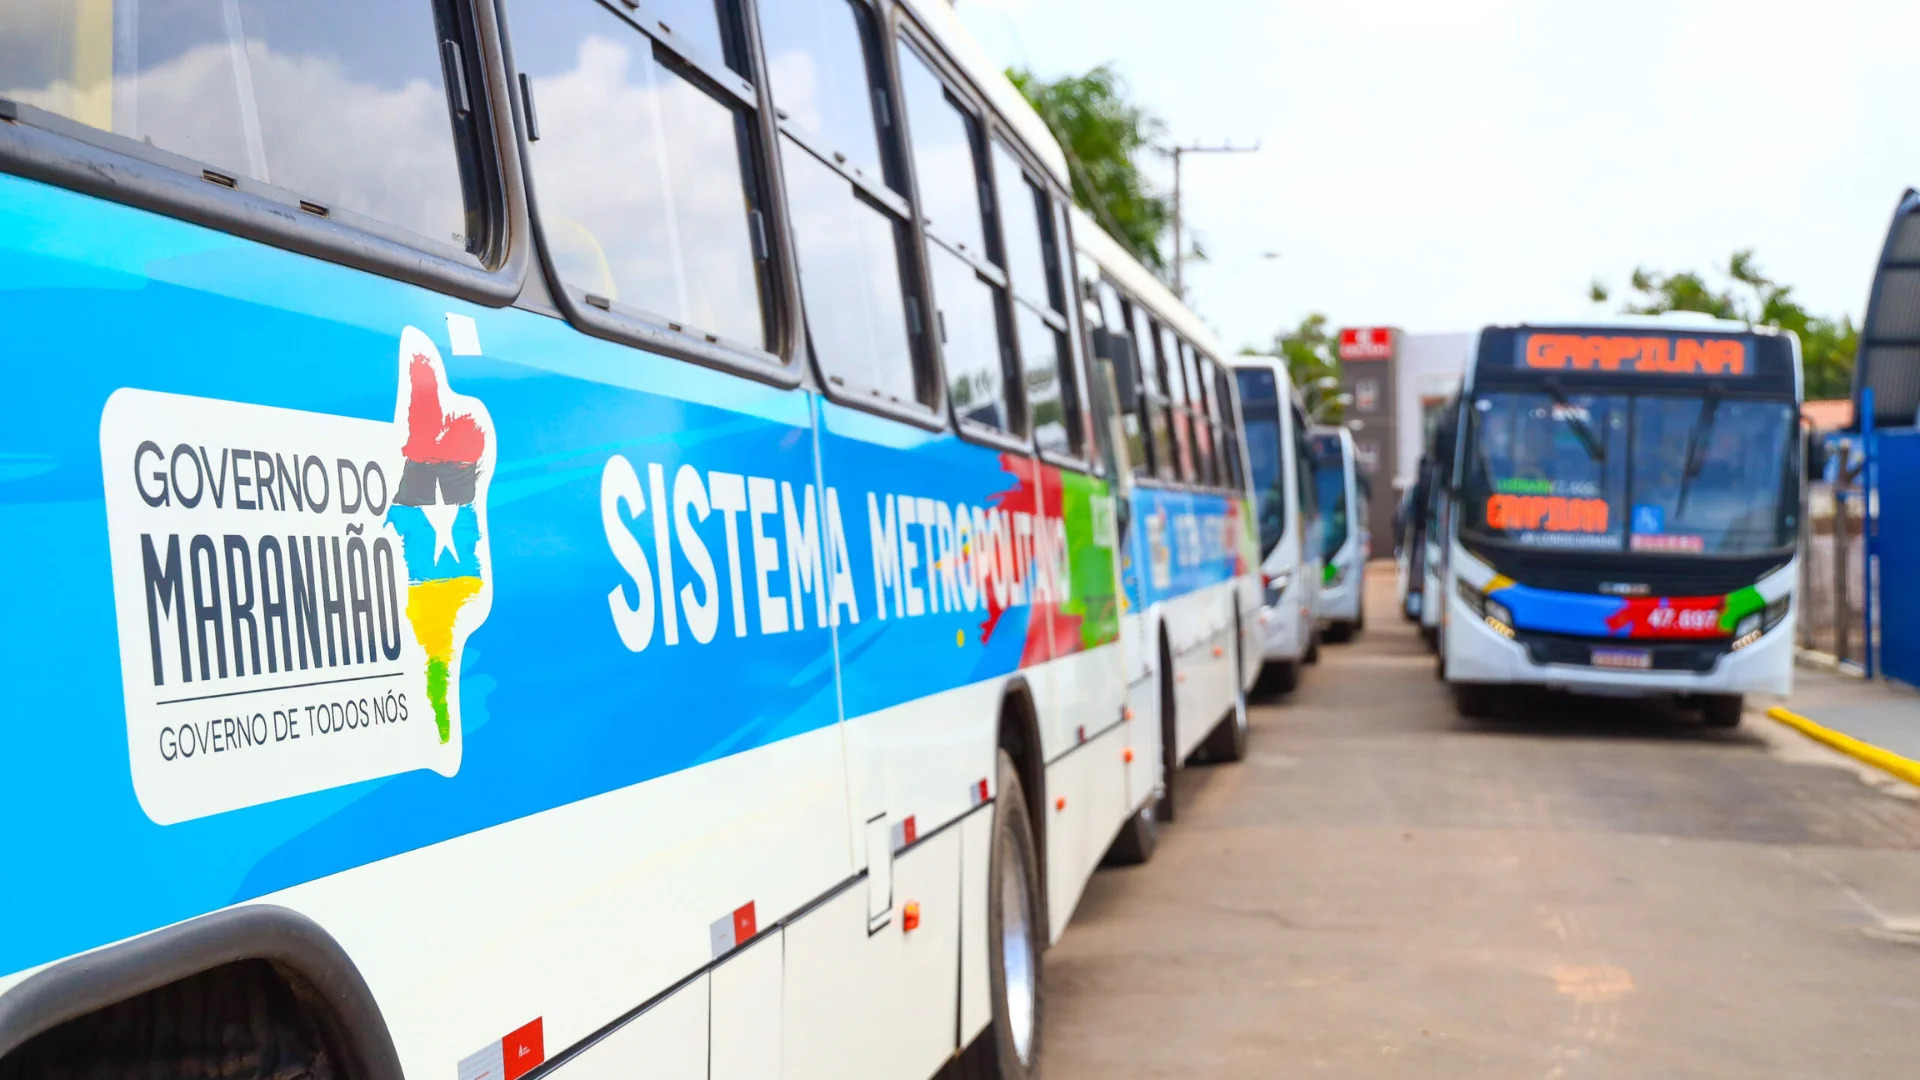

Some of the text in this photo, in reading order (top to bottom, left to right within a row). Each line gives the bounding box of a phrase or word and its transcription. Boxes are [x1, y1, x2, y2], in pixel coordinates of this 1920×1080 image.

[134, 440, 387, 517] GOVERNO DO
[141, 522, 402, 686] MARANHÃO
[600, 454, 860, 652] SISTEMA
[867, 491, 1070, 621] METROPOLITANO
[159, 689, 408, 762] GOVERNO DE TODOS NÓS
